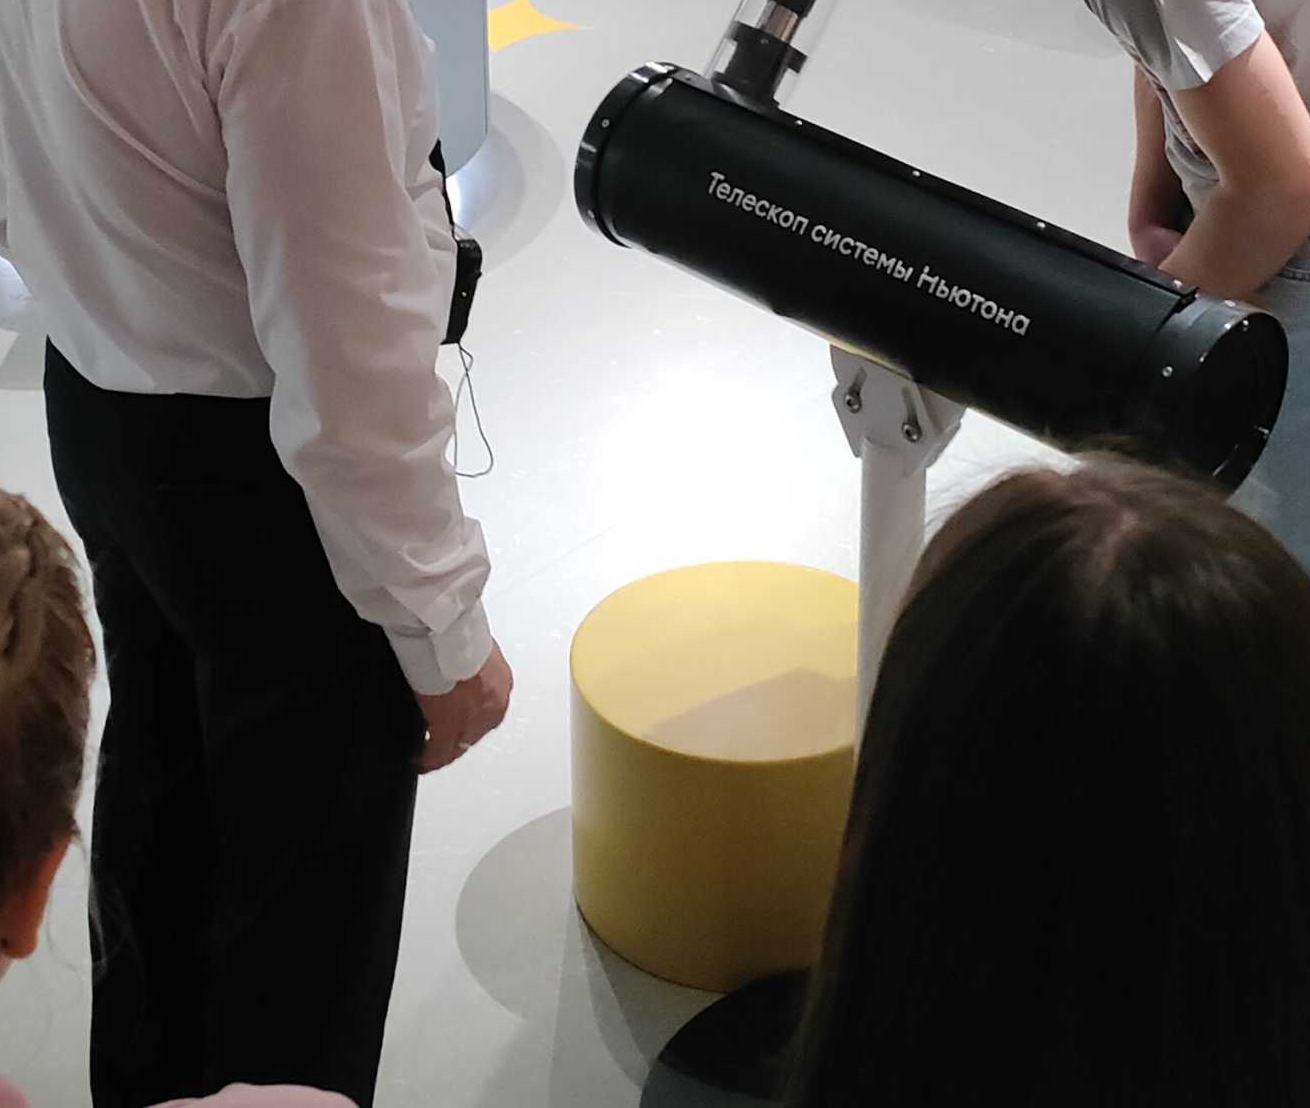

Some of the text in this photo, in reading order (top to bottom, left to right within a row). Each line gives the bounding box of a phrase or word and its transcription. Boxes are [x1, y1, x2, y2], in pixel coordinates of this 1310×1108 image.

[707, 171, 1031, 336] Телескоп системы Ньютона
